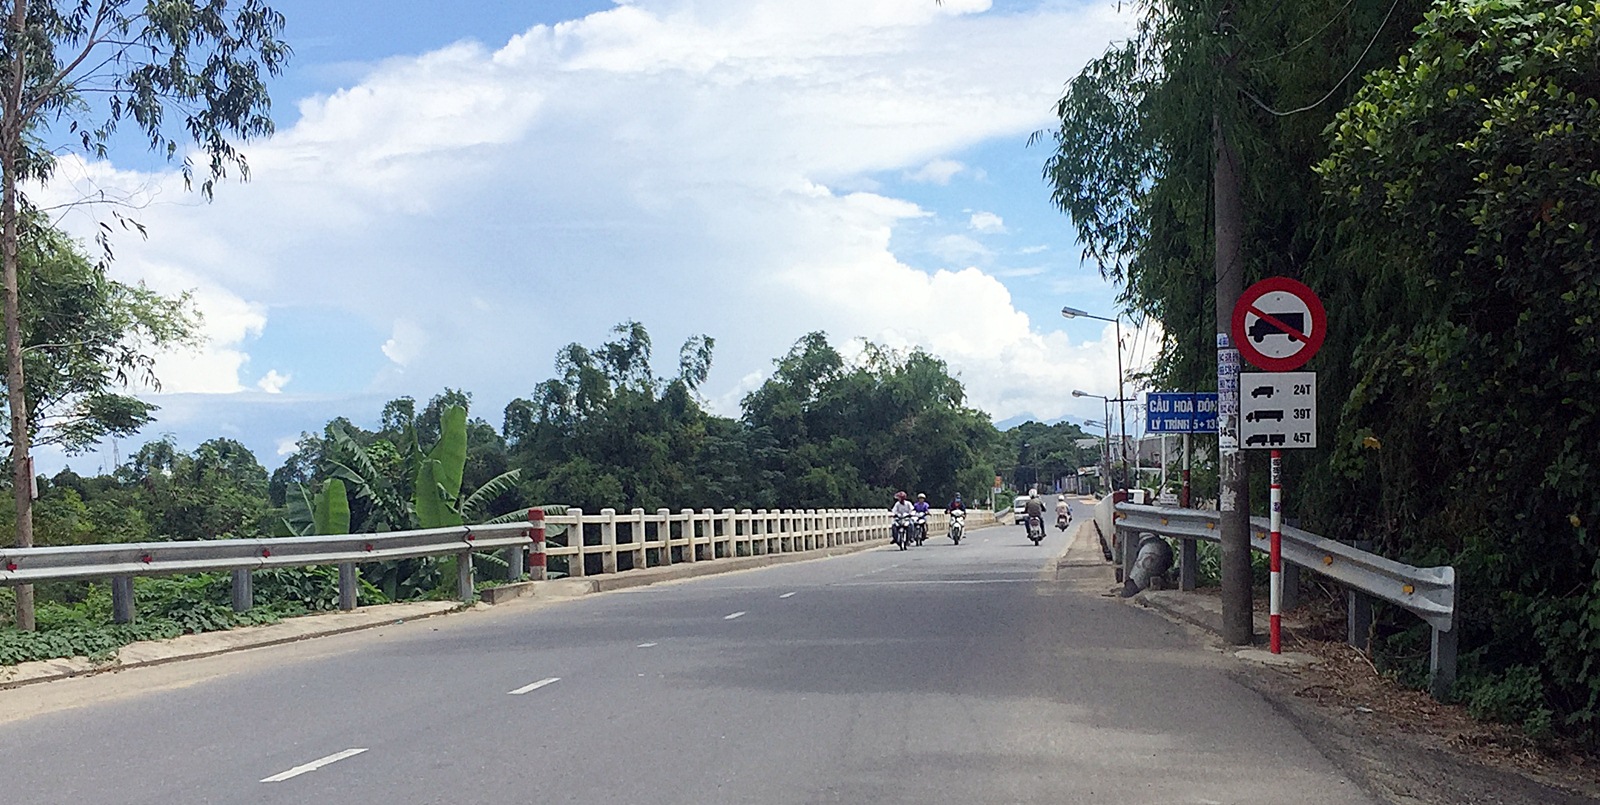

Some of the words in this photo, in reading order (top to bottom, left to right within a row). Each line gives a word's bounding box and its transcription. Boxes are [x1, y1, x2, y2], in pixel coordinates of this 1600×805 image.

[1293, 384, 1311, 395] 24T
[1149, 396, 1170, 413] CẦU
[1173, 397, 1194, 413] HOÀ
[1293, 409, 1311, 419] 39T
[1151, 417, 1162, 430] LÝ
[1293, 433, 1311, 443] 45T
